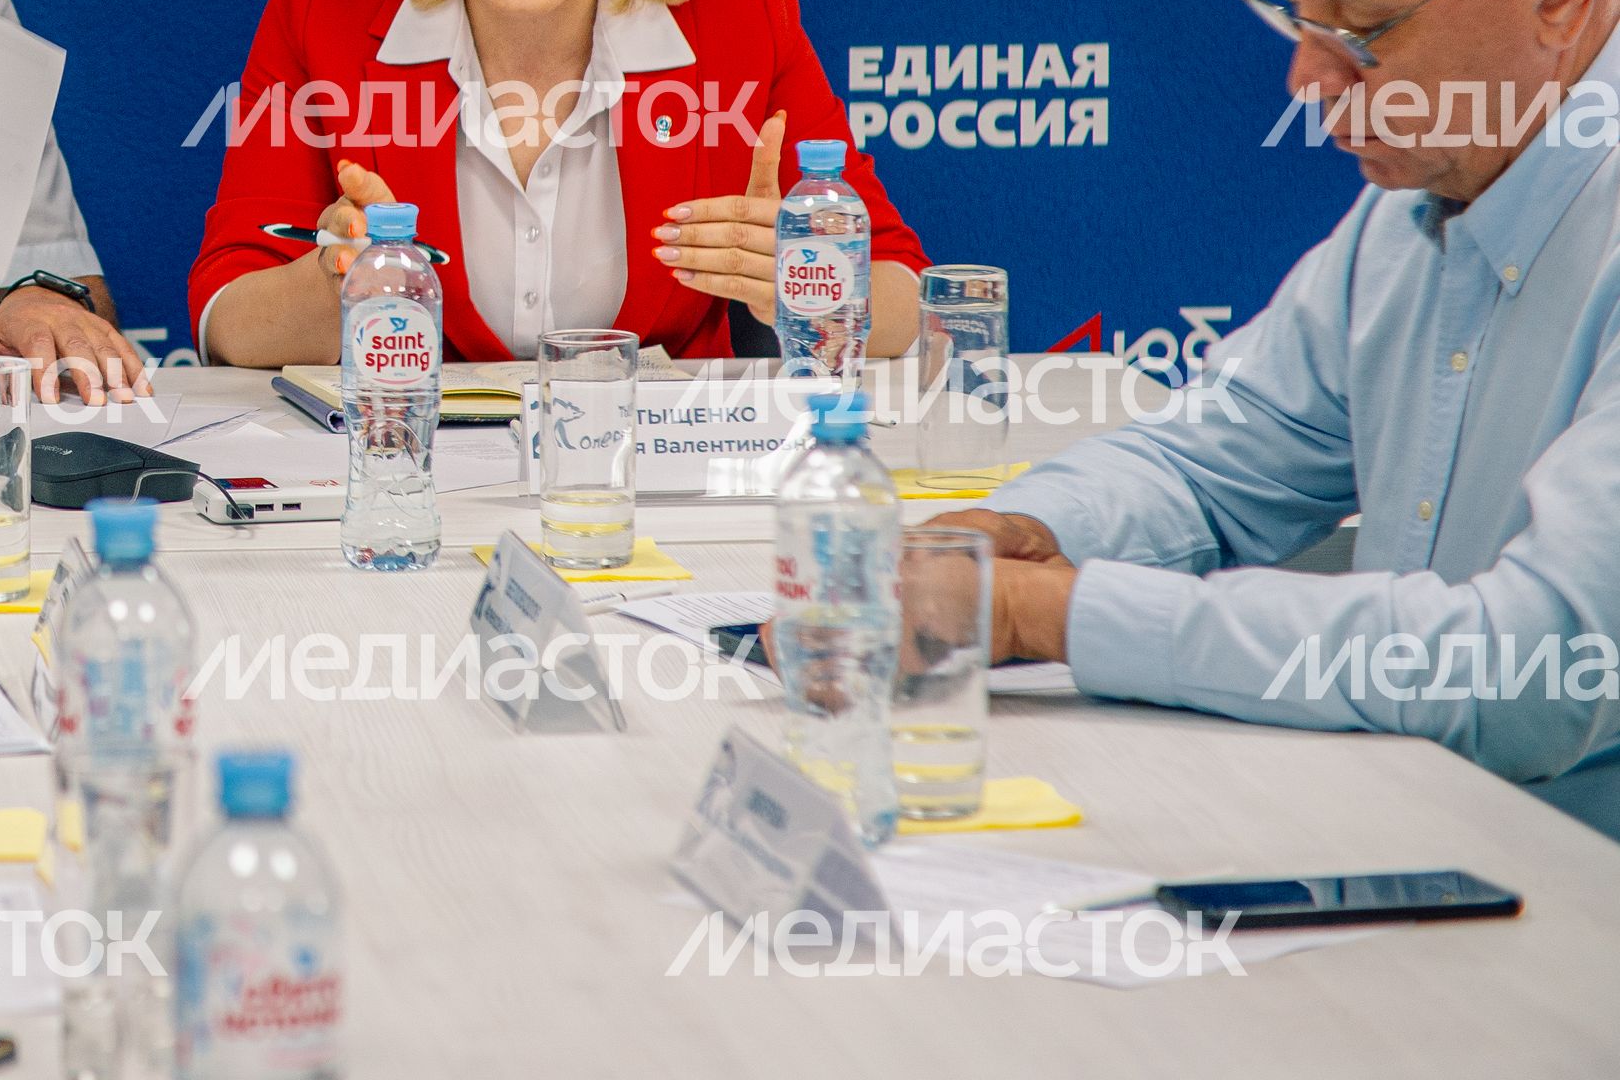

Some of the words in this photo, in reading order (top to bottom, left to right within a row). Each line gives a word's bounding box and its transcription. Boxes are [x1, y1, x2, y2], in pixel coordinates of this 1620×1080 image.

[849, 42, 1109, 95] ЕДИНАЯ
[849, 97, 1109, 149] РОССИЯ
[787, 263, 837, 281] saint
[784, 280, 843, 302] spring
[371, 331, 425, 350] saint
[365, 351, 430, 373] spring
